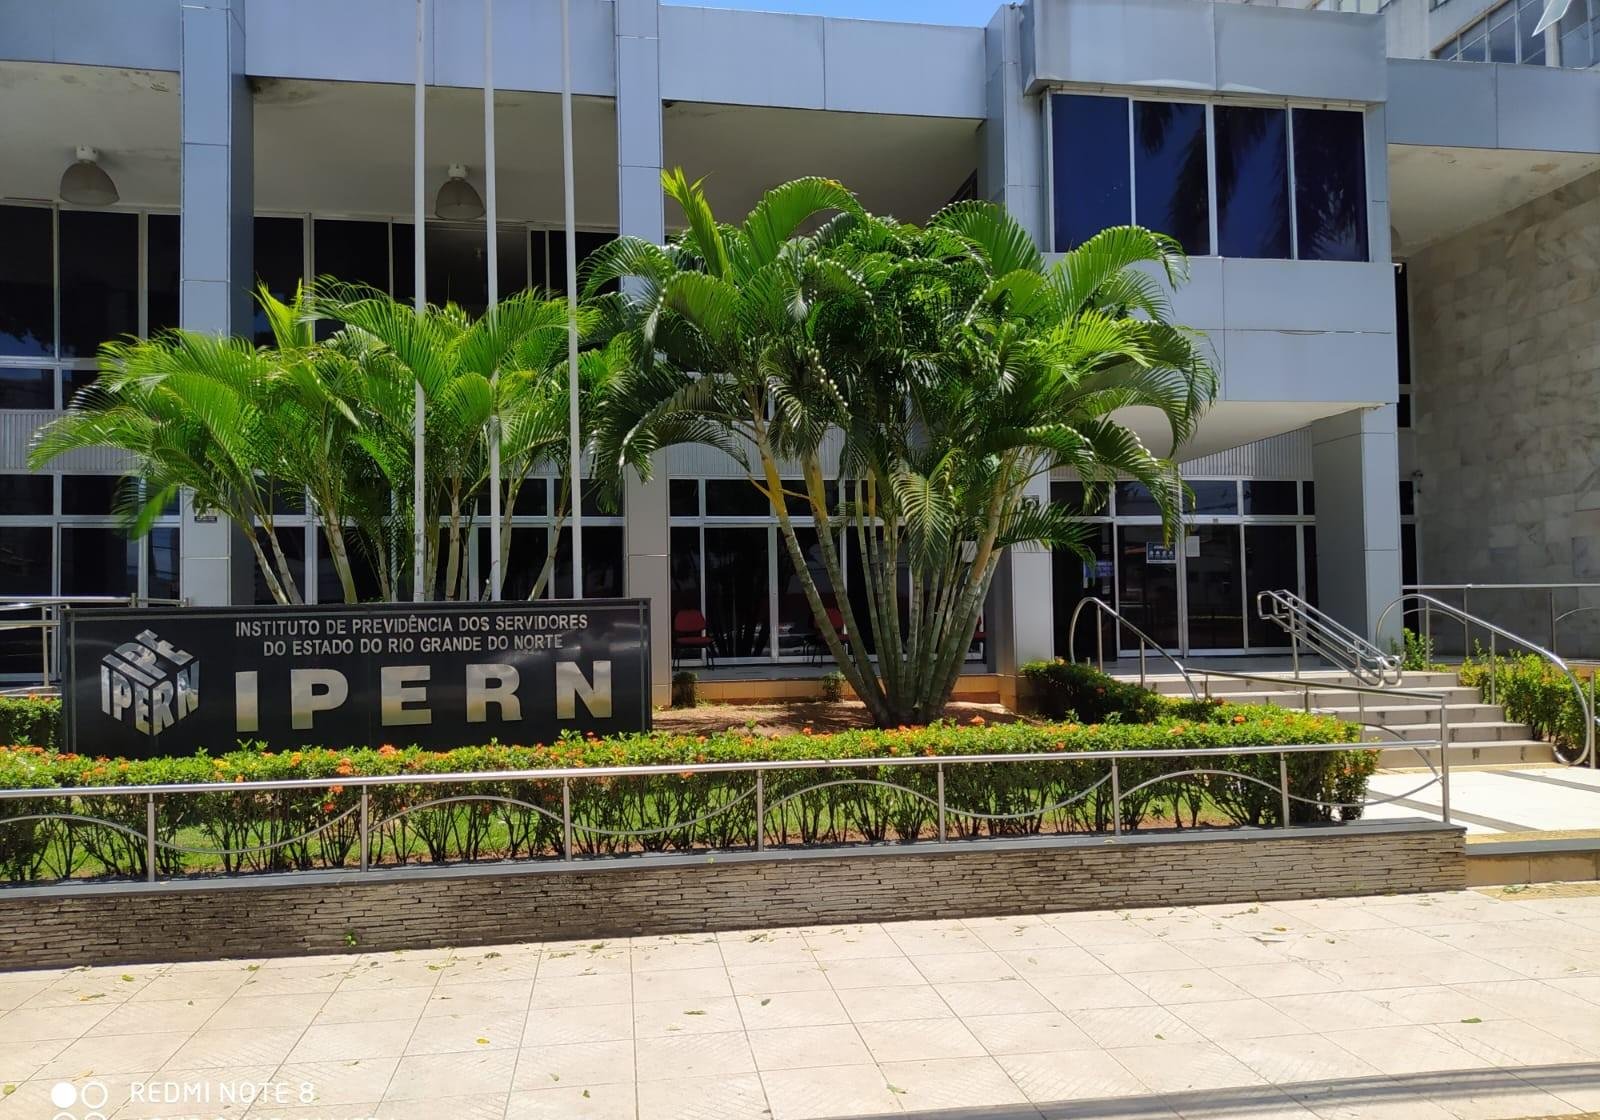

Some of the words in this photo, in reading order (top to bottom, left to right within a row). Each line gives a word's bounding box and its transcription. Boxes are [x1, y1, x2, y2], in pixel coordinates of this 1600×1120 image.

[235, 619, 320, 637] INSTITUTO
[326, 619, 347, 635] DE
[352, 614, 453, 635] PREVIDÊNCIA
[459, 616, 490, 632] DOS
[495, 614, 588, 631] SERVIDORES
[263, 640, 287, 657] DO
[292, 639, 354, 656] ESTADO
[360, 638, 383, 654] DO
[388, 638, 414, 653] RIO
[420, 636, 482, 652] GRANDE
[488, 635, 509, 650] DO
[514, 634, 563, 649] NORTE
[235, 660, 612, 732] IPERN
